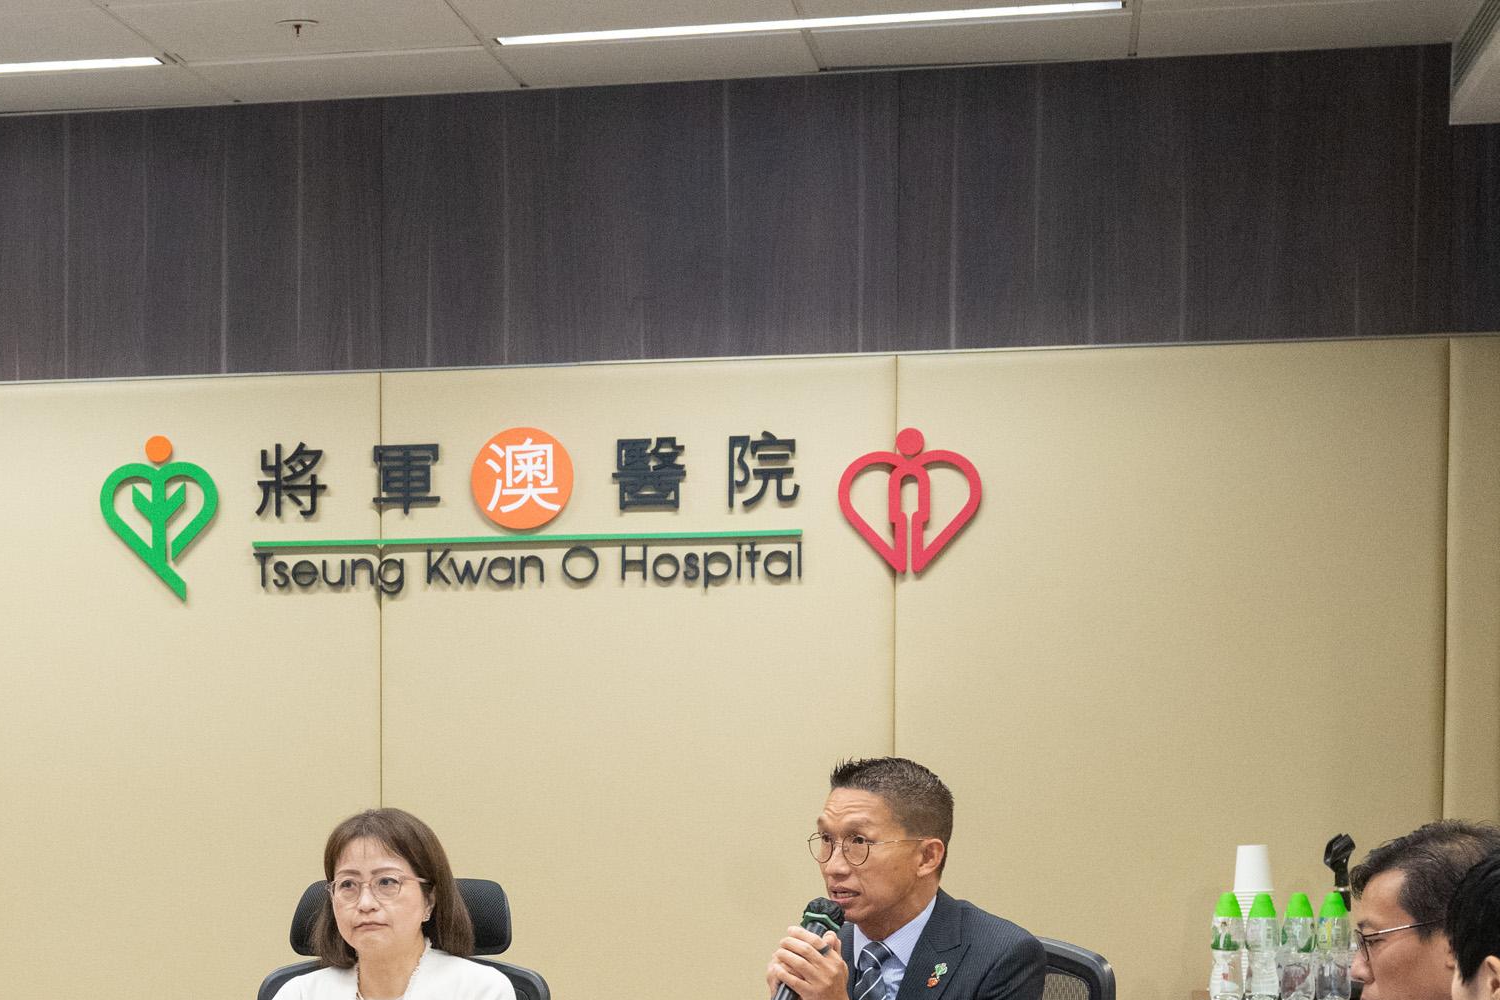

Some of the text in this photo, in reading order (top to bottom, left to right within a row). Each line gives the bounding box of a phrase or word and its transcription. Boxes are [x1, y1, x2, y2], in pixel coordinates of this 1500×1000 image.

[255, 431, 800, 518] 將軍澳醫院
[253, 541, 803, 595] Tseung Kwan O Hospital
